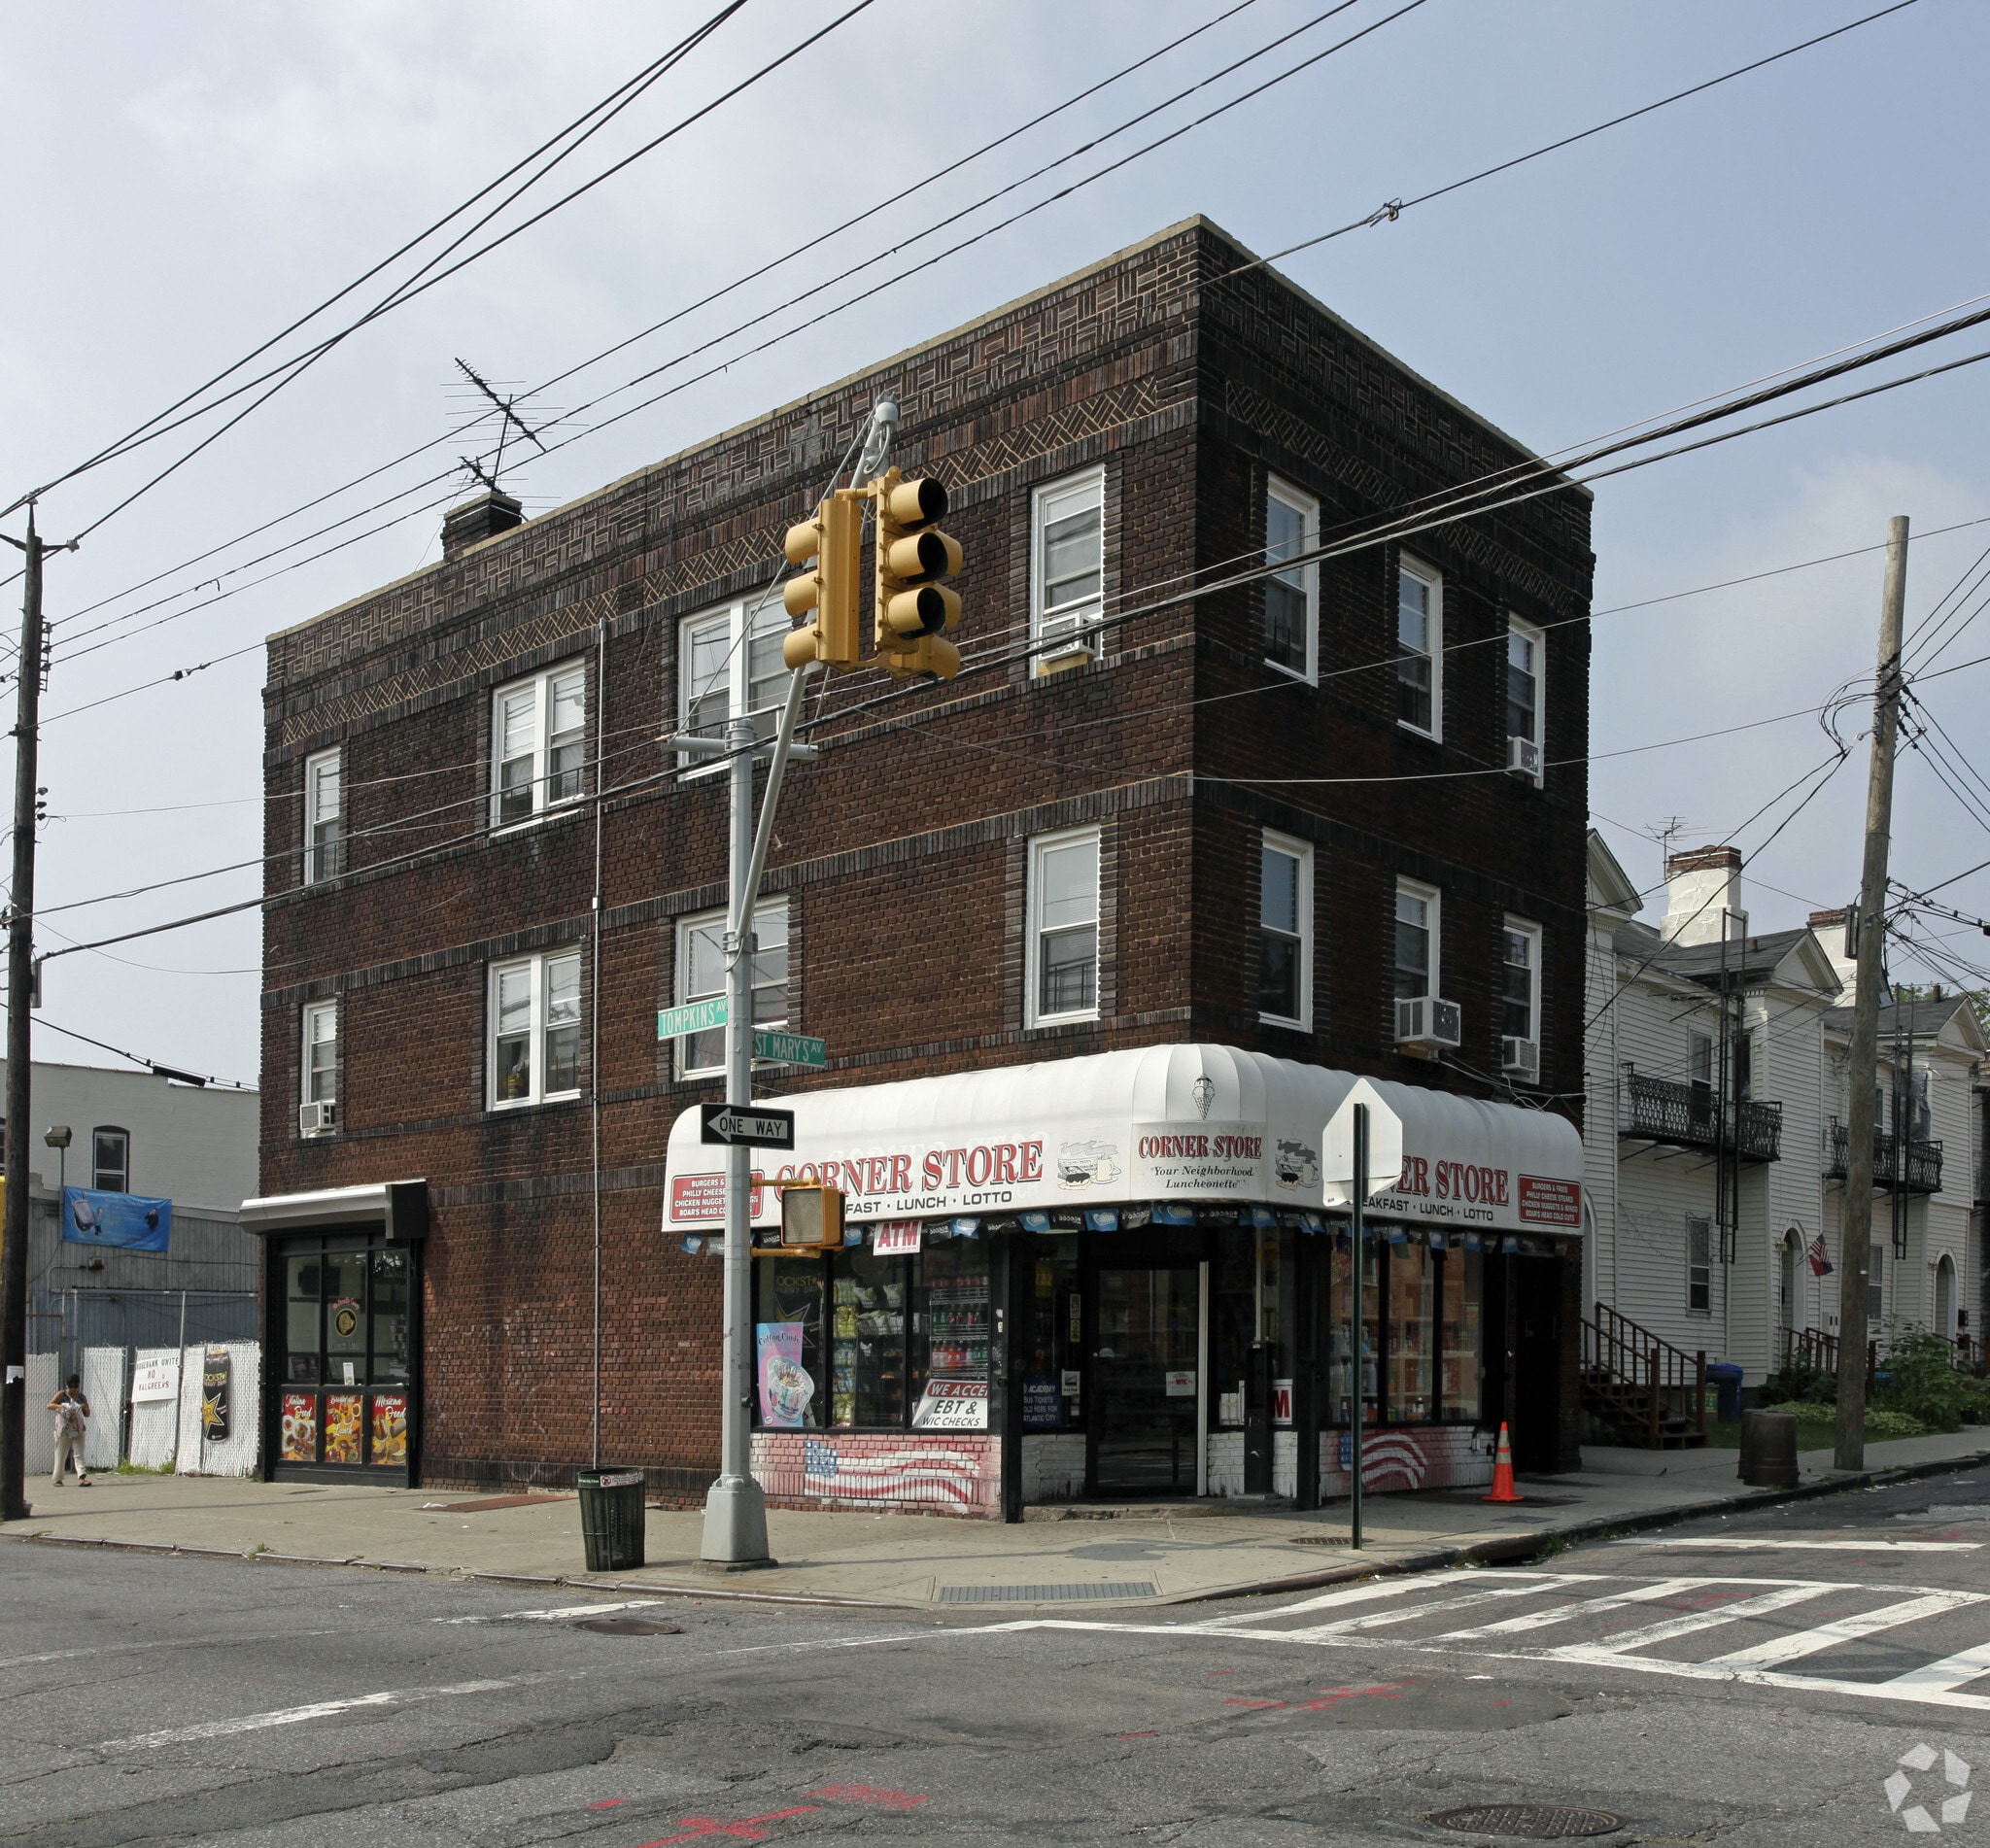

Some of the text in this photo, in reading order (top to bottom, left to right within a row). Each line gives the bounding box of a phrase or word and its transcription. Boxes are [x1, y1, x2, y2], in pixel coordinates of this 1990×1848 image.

[661, 999, 727, 1036] TOMPKINS AV
[755, 1032, 823, 1062] ST MARY'S AV
[719, 1116, 782, 1137] ONE WAY
[1138, 1135, 1262, 1160] CORNER STORE
[923, 1140, 1044, 1191] STORE
[691, 1179, 719, 1187] BURGERS
[1434, 1159, 1509, 1207] STORE
[1531, 1181, 1552, 1191] BURGERS
[674, 1199, 701, 1208] CHICKEN
[897, 1196, 946, 1212] LUNCH
[963, 1190, 1012, 1206] LOTTO
[1526, 1190, 1541, 1199] PHILLY
[701, 1207, 717, 1215] HEAD
[1362, 1197, 1493, 1222] EAKFAST LUNCH LOTTO
[877, 1220, 920, 1249] ATM
[931, 1383, 987, 1397] WE ACCE
[1028, 1385, 1056, 1393] ACADEMY
[933, 1399, 978, 1415] EBT &
[922, 1417, 980, 1426] WIC CHECKS
